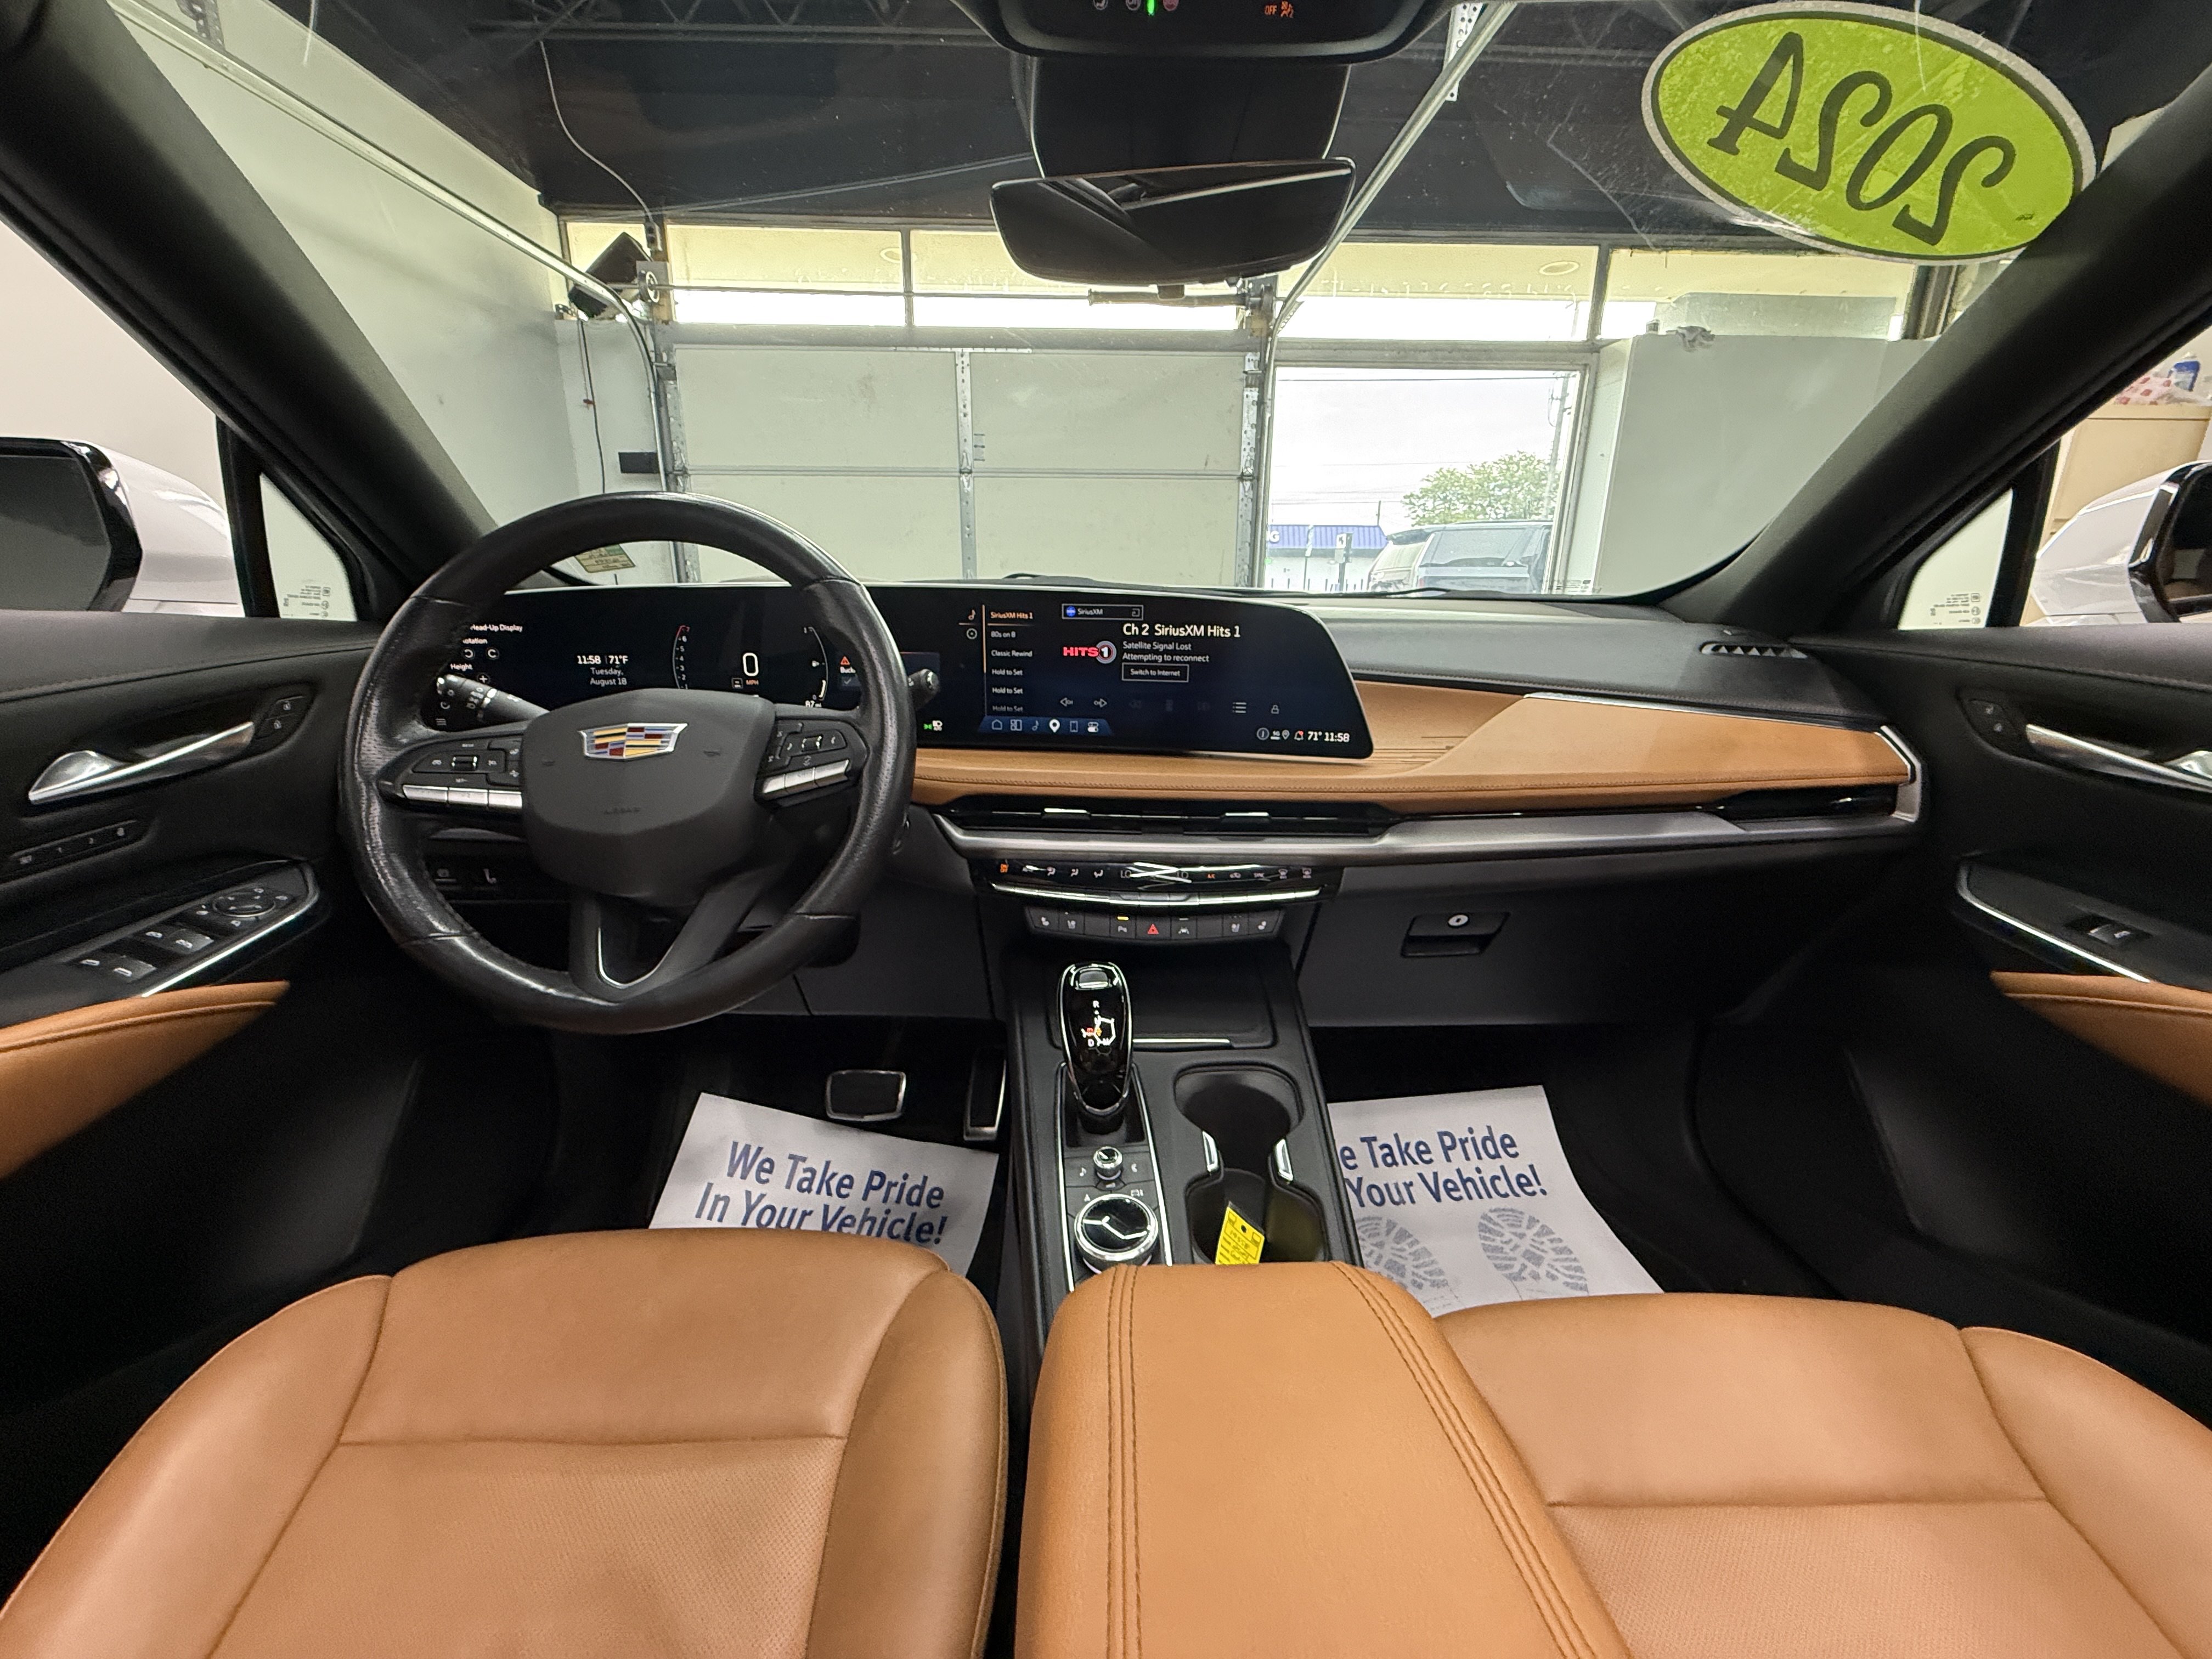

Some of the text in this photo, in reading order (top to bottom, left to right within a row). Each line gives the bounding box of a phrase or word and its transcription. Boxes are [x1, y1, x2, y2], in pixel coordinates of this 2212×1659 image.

[1264, 5, 1277, 15] OFF
[499, 624, 523, 633] Display
[1123, 623, 1241, 637] Ch 2 SiriusXM Hits 1
[1063, 646, 1099, 657] HITS
[1123, 641, 1192, 652] Satellite Signal Lost
[577, 655, 628, 664] 11:58 71°F
[1122, 652, 1163, 663] Attempting
[1173, 654, 1210, 663] reconnect
[450, 663, 473, 672] Height
[742, 652, 759, 676] 0
[590, 667, 624, 676] Tuesday,
[590, 678, 617, 687] August
[1308, 731, 1350, 742] 71° 11:58
[1093, 1000, 1100, 1008] R
[1087, 1039, 1095, 1047] D
[1341, 1125, 1520, 1170] e Take Pride
[727, 1141, 945, 1209] We Take Pride
[1345, 1164, 1548, 1207] Your Vehicle!
[695, 1182, 948, 1245] In Your Vehicle!
